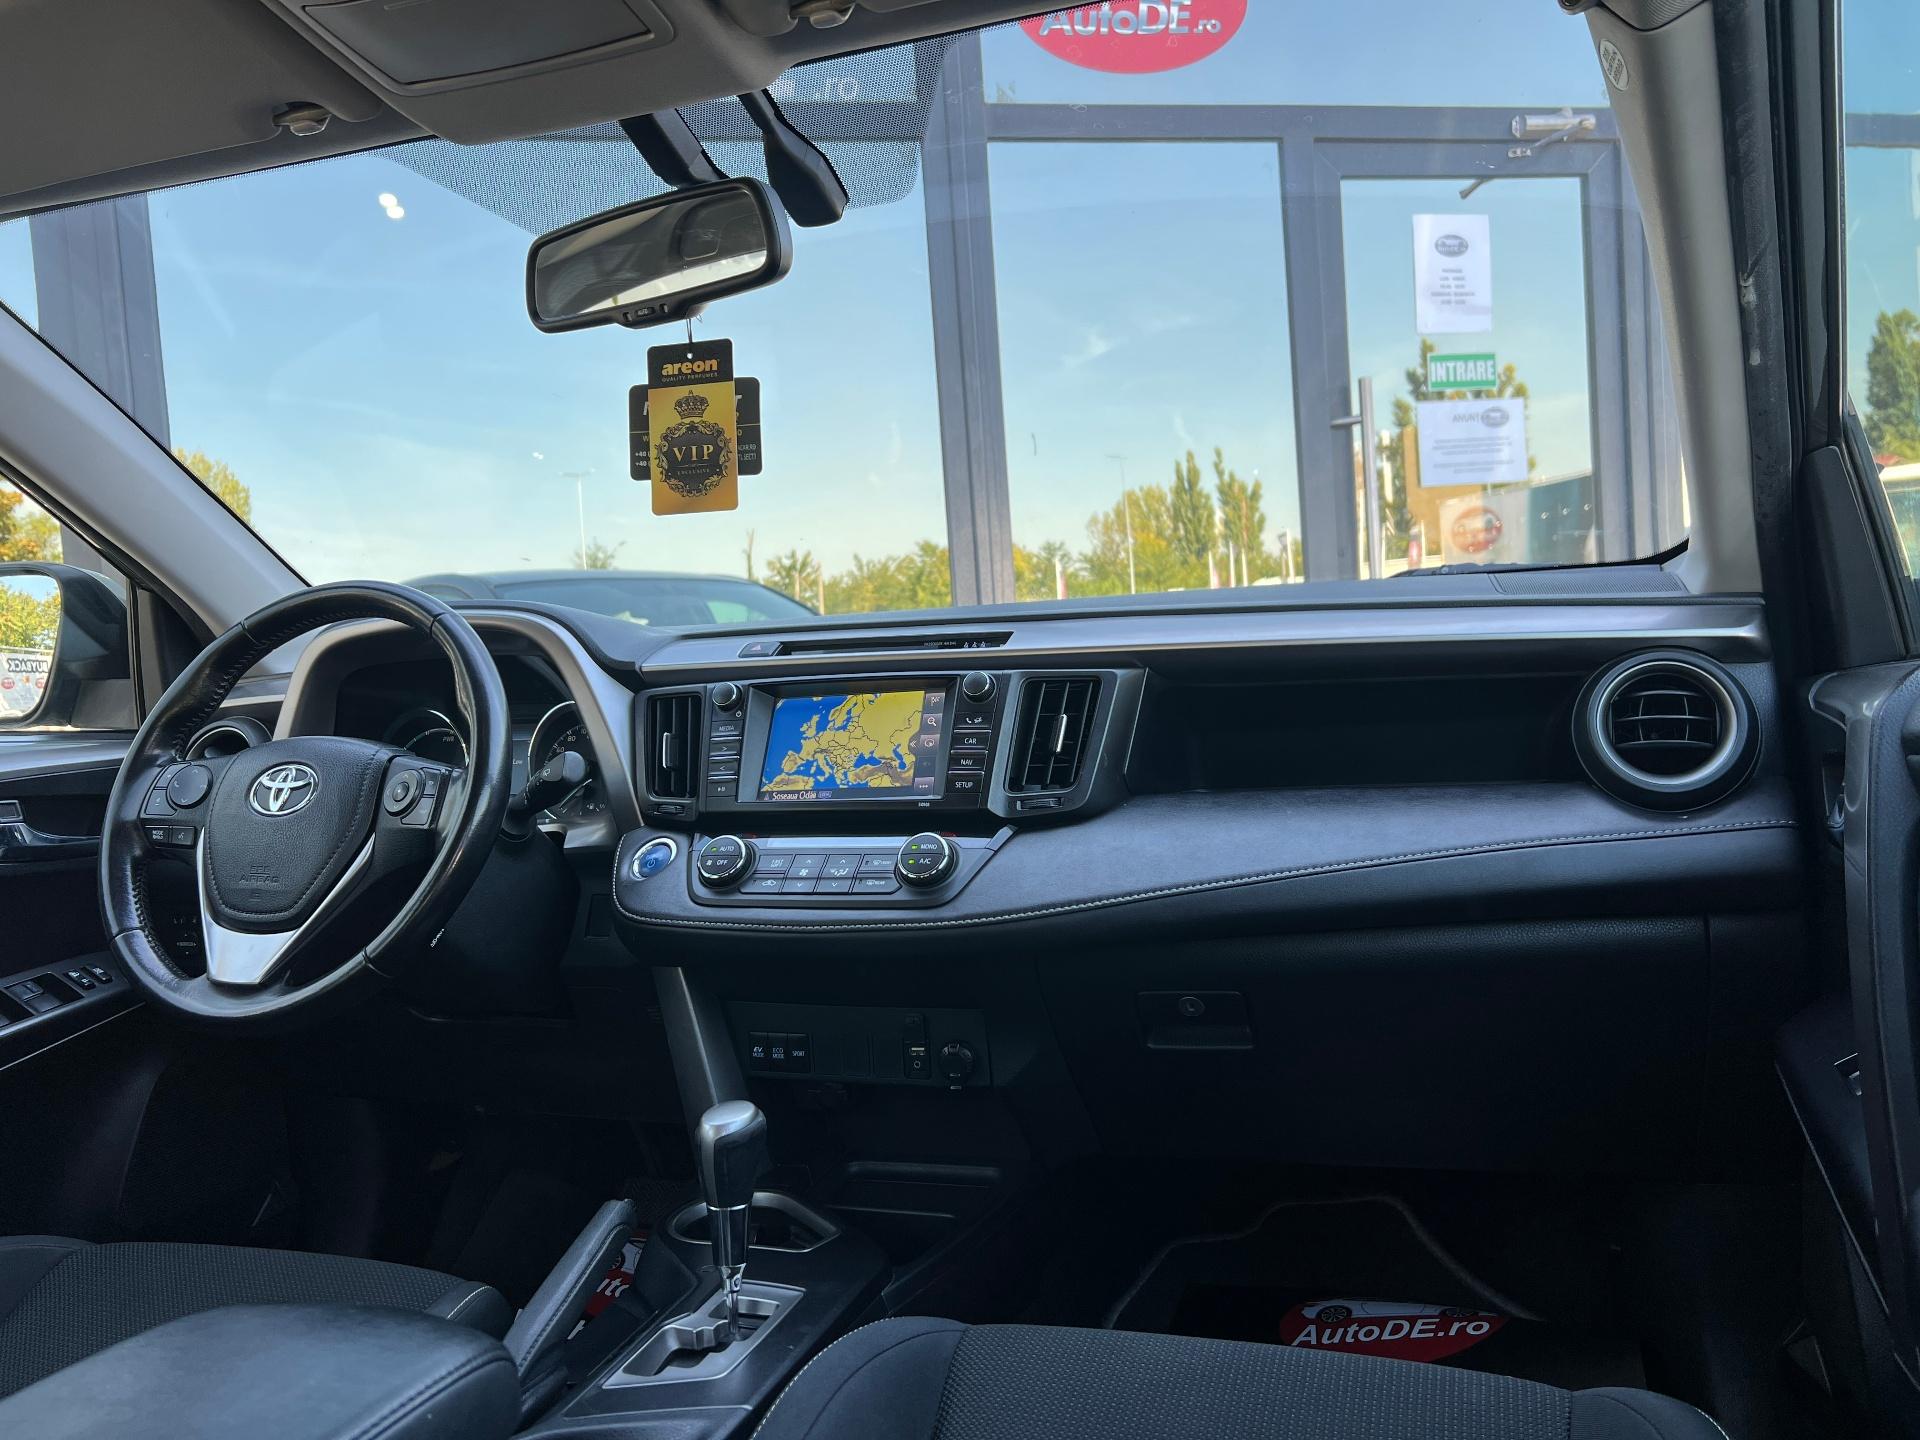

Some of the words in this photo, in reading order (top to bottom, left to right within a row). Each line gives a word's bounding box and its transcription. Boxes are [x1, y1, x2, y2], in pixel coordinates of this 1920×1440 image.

[661, 359, 718, 376] areon
[1430, 359, 1496, 383] INTRARE
[672, 444, 714, 463] VIP
[964, 737, 977, 745] CAR
[960, 758, 973, 766] NAV
[955, 781, 974, 789] SETUP
[1291, 1317, 1490, 1347] AutoDE.ro
